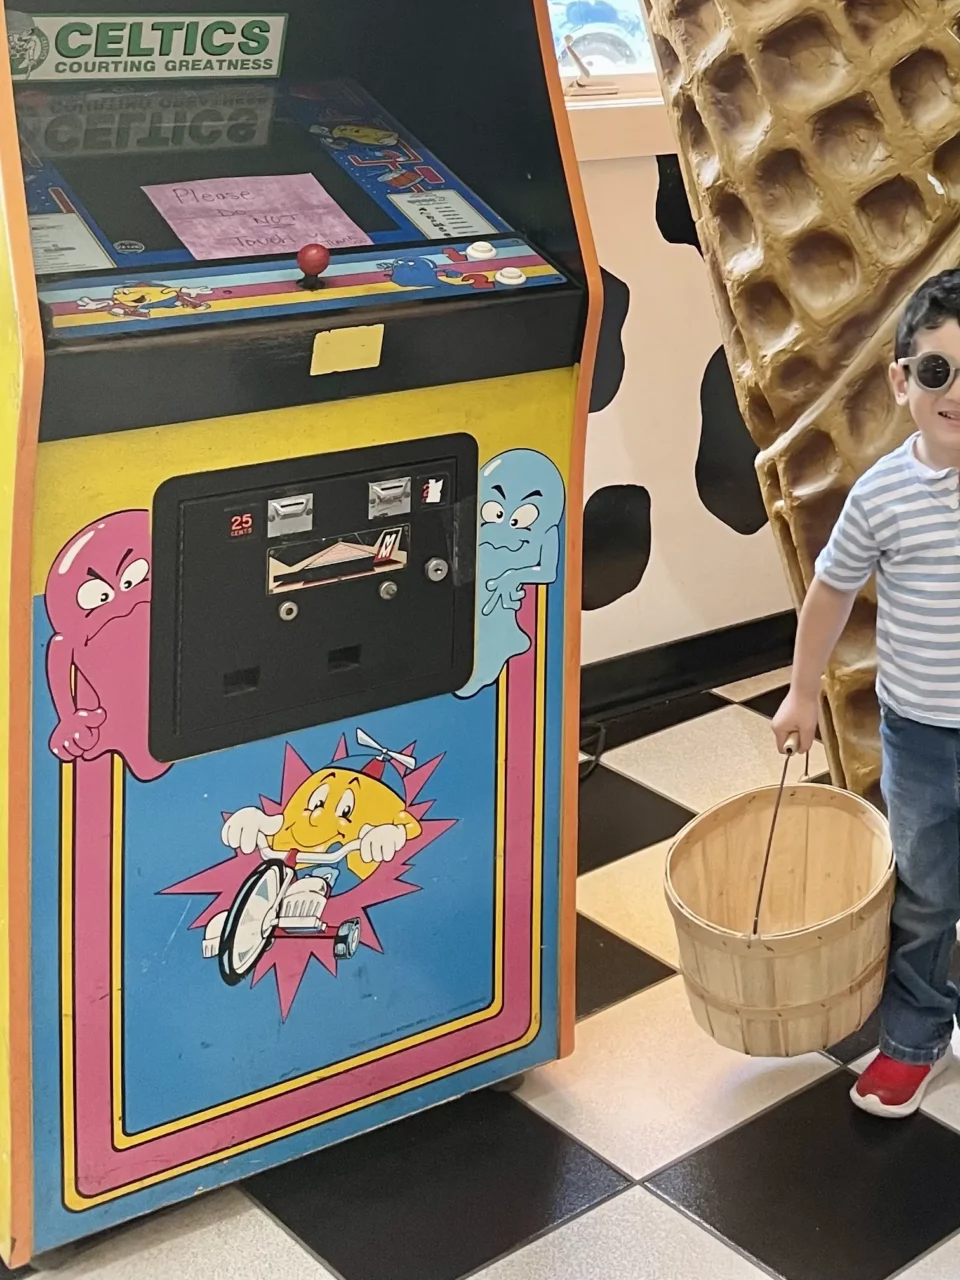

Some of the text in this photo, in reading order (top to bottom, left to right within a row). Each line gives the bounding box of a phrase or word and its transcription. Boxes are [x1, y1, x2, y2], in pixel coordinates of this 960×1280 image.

[54, 20, 271, 58] CELTICS
[54, 58, 273, 74] COURTING GREATNESS
[173, 187, 255, 204] Please
[231, 513, 252, 531] 25
